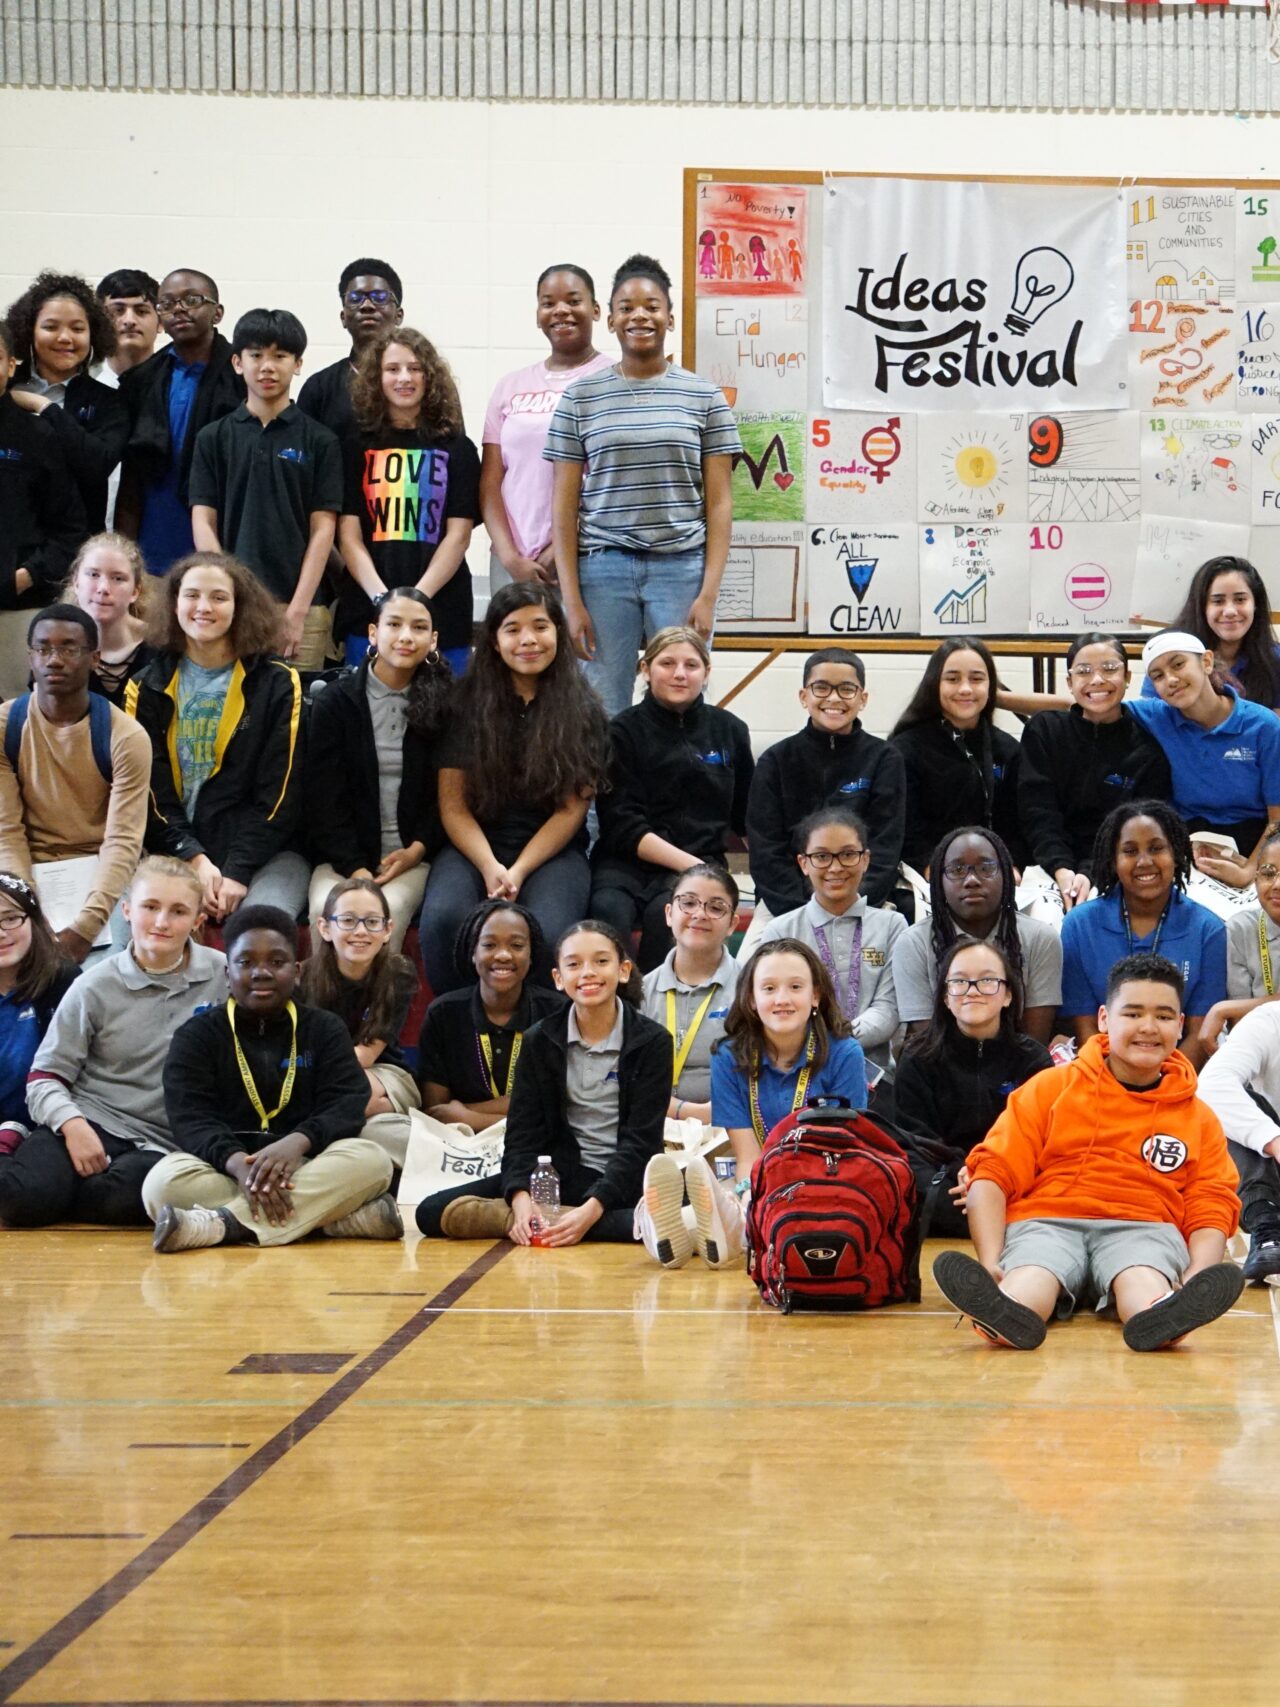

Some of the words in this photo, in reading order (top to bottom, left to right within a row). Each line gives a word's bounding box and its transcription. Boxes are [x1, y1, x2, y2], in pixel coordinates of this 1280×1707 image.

[701, 187, 711, 199] 1
[1130, 196, 1157, 227] 11
[1162, 195, 1235, 210] SUSTAINABLE
[1243, 197, 1269, 216] 15
[1178, 211, 1213, 224] CITIES
[1184, 224, 1207, 236] AND
[1158, 237, 1224, 250] COMMUNITIES
[845, 252, 988, 332] Ideas
[716, 308, 760, 336] End
[792, 305, 801, 321] 2
[1129, 299, 1165, 333] 12
[1241, 309, 1275, 346] 16
[738, 340, 806, 378] Hunger
[874, 319, 1084, 393] Festival
[1239, 385, 1280, 403] STRONG
[1010, 414, 1024, 431] 7
[1149, 418, 1166, 432] 13
[1171, 418, 1212, 432] CLIMATE
[1212, 418, 1245, 430] ACTION
[812, 419, 831, 447] 5
[1028, 415, 1064, 468] 9
[367, 452, 445, 488] LOVE
[820, 459, 871, 475] Gender
[819, 477, 867, 494] Equality
[372, 496, 438, 535] WINS
[730, 531, 747, 544] ality
[925, 528, 935, 545] 8
[954, 525, 1002, 538] Decent
[1029, 525, 1064, 550] 10
[836, 542, 868, 560] ALL
[830, 604, 901, 632] CLEAN
[1145, 1138, 1182, 1167] 悟
